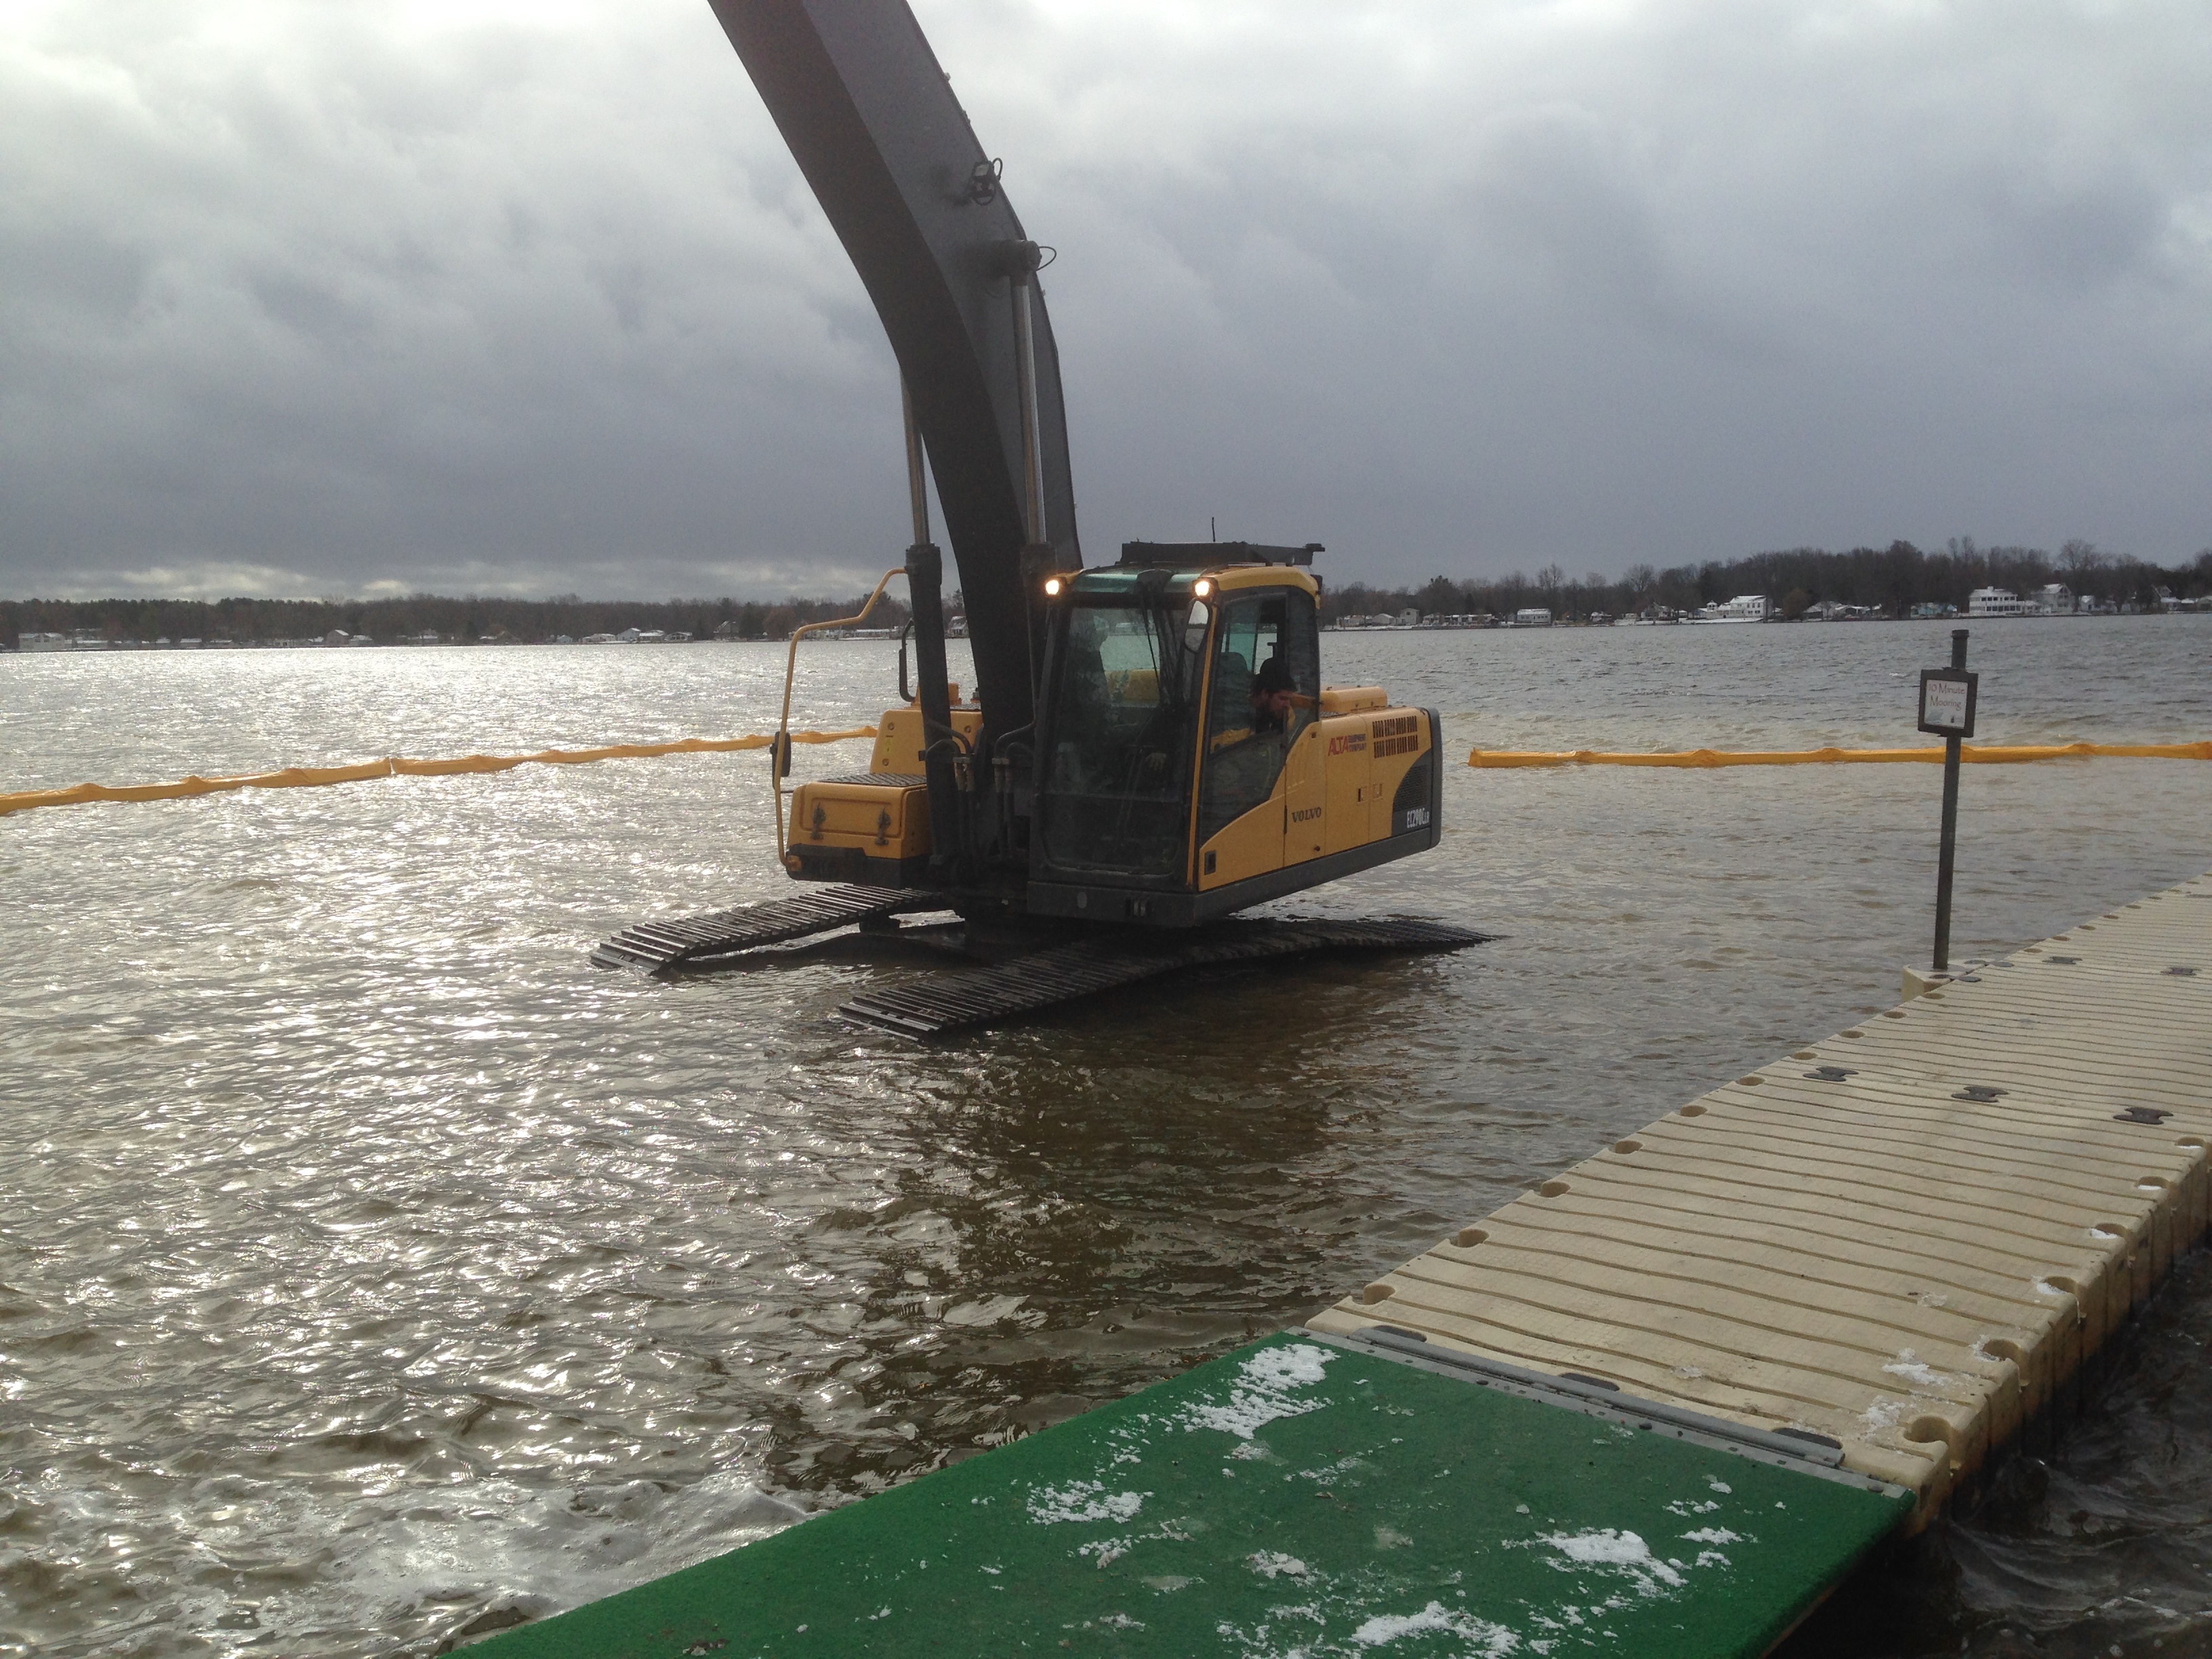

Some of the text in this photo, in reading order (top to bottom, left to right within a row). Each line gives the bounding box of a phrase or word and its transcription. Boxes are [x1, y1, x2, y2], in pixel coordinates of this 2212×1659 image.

[1929, 682, 1965, 694] 10 Minute
[1929, 695, 1961, 711] Mooring
[1328, 735, 1349, 756] ALTA
[1292, 806, 1322, 823] VOLVO
